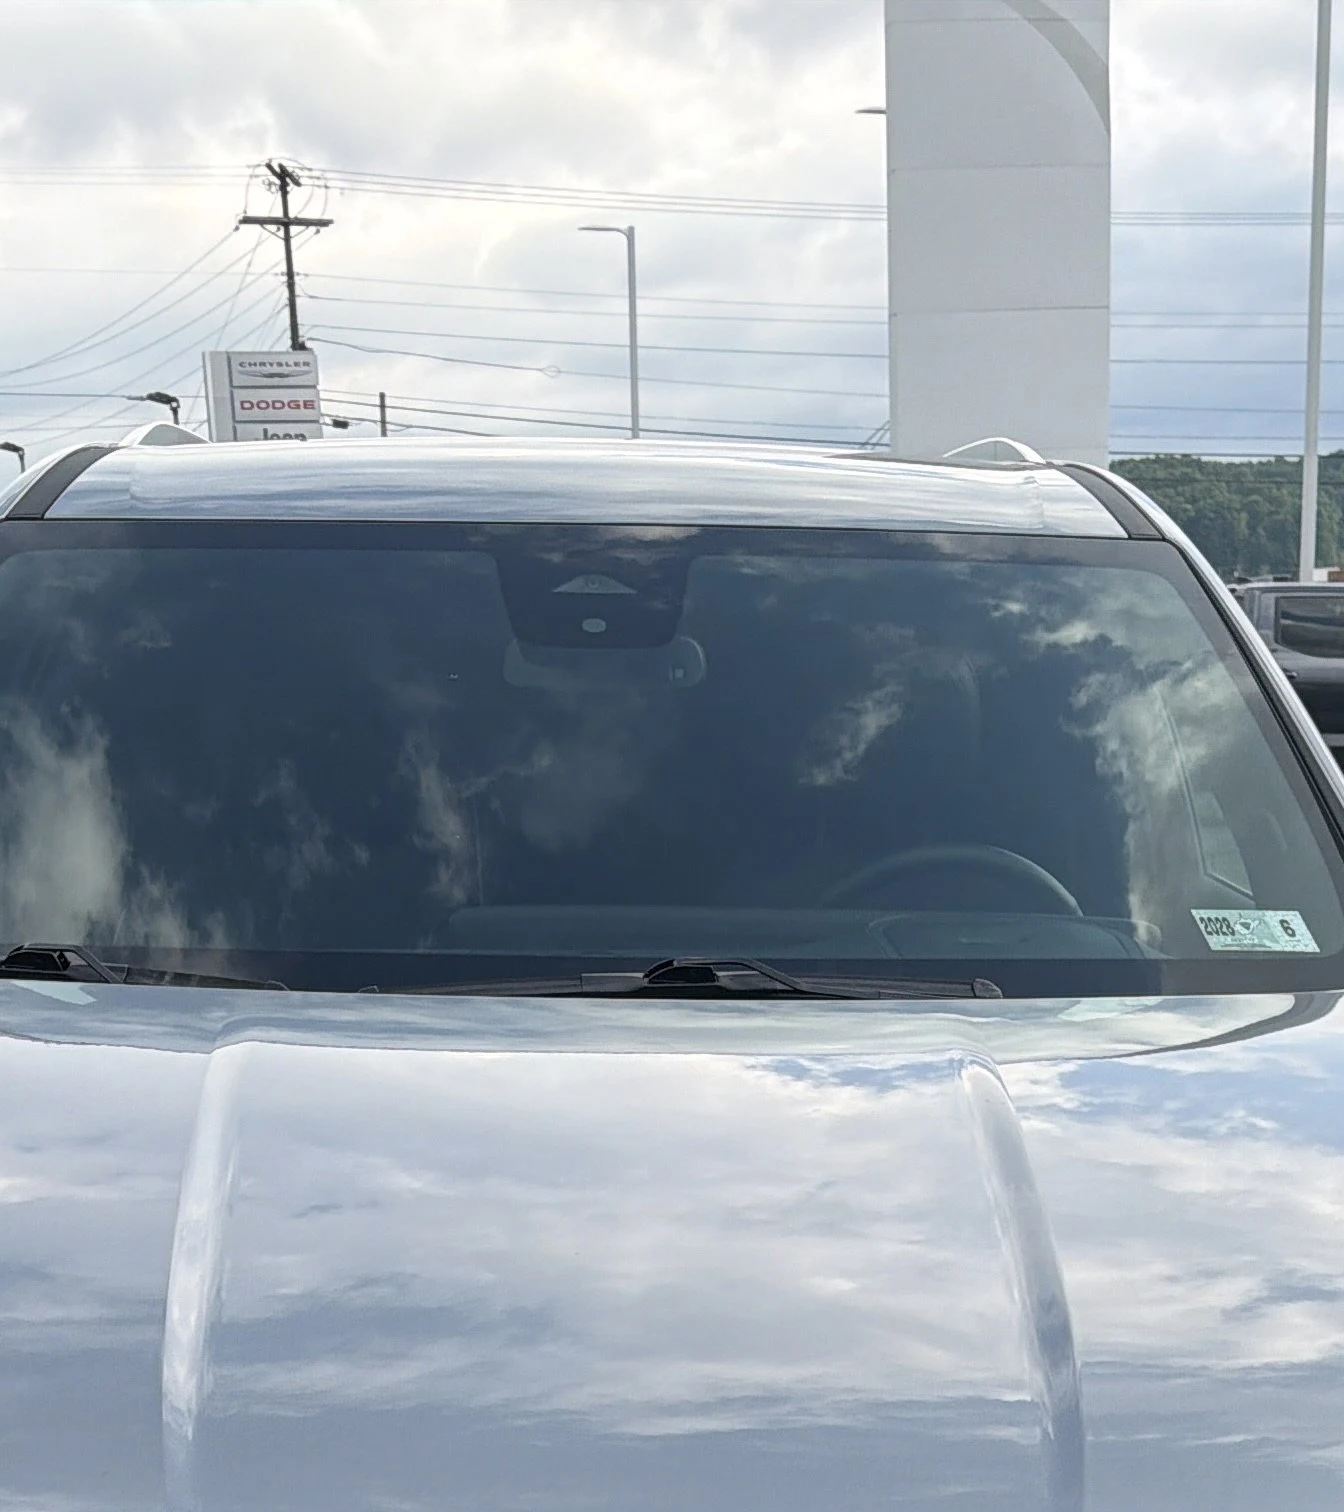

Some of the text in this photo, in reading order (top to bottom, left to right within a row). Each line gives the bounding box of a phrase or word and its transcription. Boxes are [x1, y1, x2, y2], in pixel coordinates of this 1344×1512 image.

[238, 361, 312, 369] CHRYSLER
[240, 400, 317, 411] DODGE
[1198, 916, 1297, 938] 2028 6
